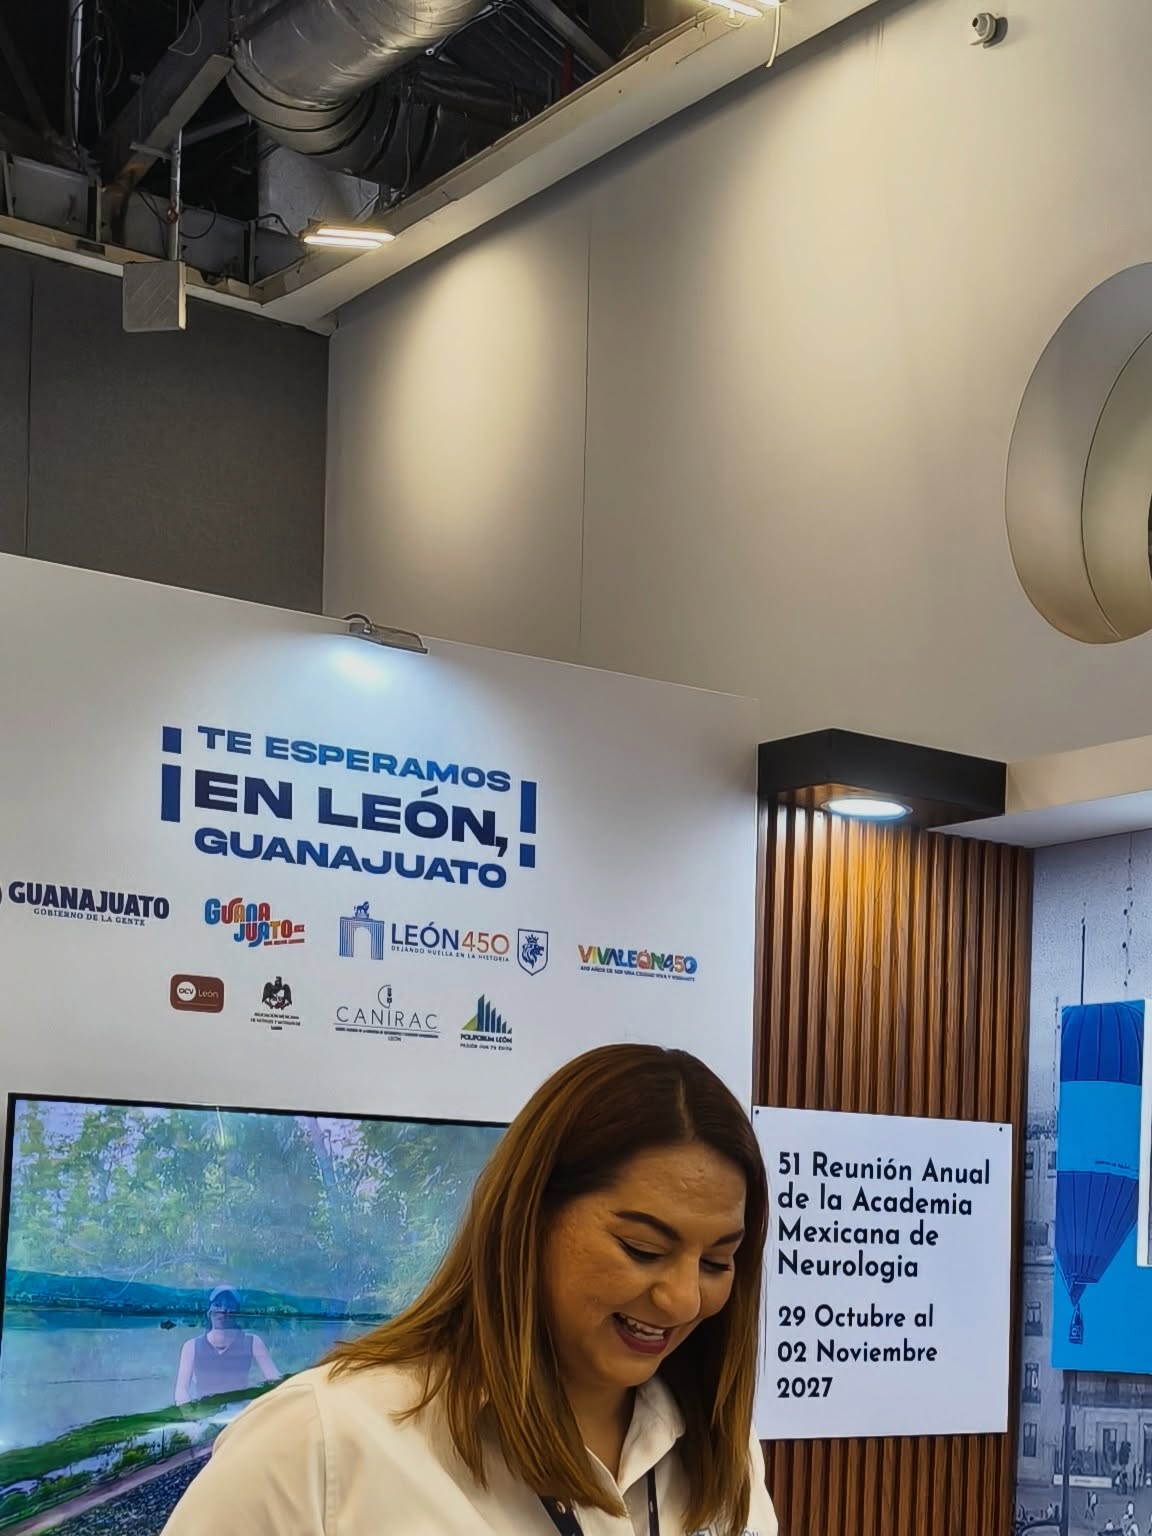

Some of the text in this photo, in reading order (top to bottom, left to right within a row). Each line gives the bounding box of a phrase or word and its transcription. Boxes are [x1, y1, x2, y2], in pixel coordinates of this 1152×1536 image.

[197, 725, 252, 755] TE
[264, 735, 511, 792] ESPERAMOS
[194, 769, 293, 820] EN
[317, 785, 509, 858] LEÓN,
[194, 827, 508, 889] GUANAJUATO
[8, 880, 170, 920] GUANAJUATO
[33, 907, 146, 927] GOBIERNO DE LA GENTE
[391, 945, 425, 955] DEJANDO
[427, 948, 454, 958] HUELLA
[336, 1005, 439, 1031] CANIRAC
[778, 1151, 990, 1185] 51 Reunión Anual
[777, 1181, 972, 1216] de la Academia
[778, 1216, 939, 1246] Mexicana de
[778, 1249, 918, 1284] Neurologia
[778, 1303, 933, 1328] 29 Octubre al
[777, 1338, 938, 1363] 02 Noviembre
[776, 1376, 833, 1398] 2027
